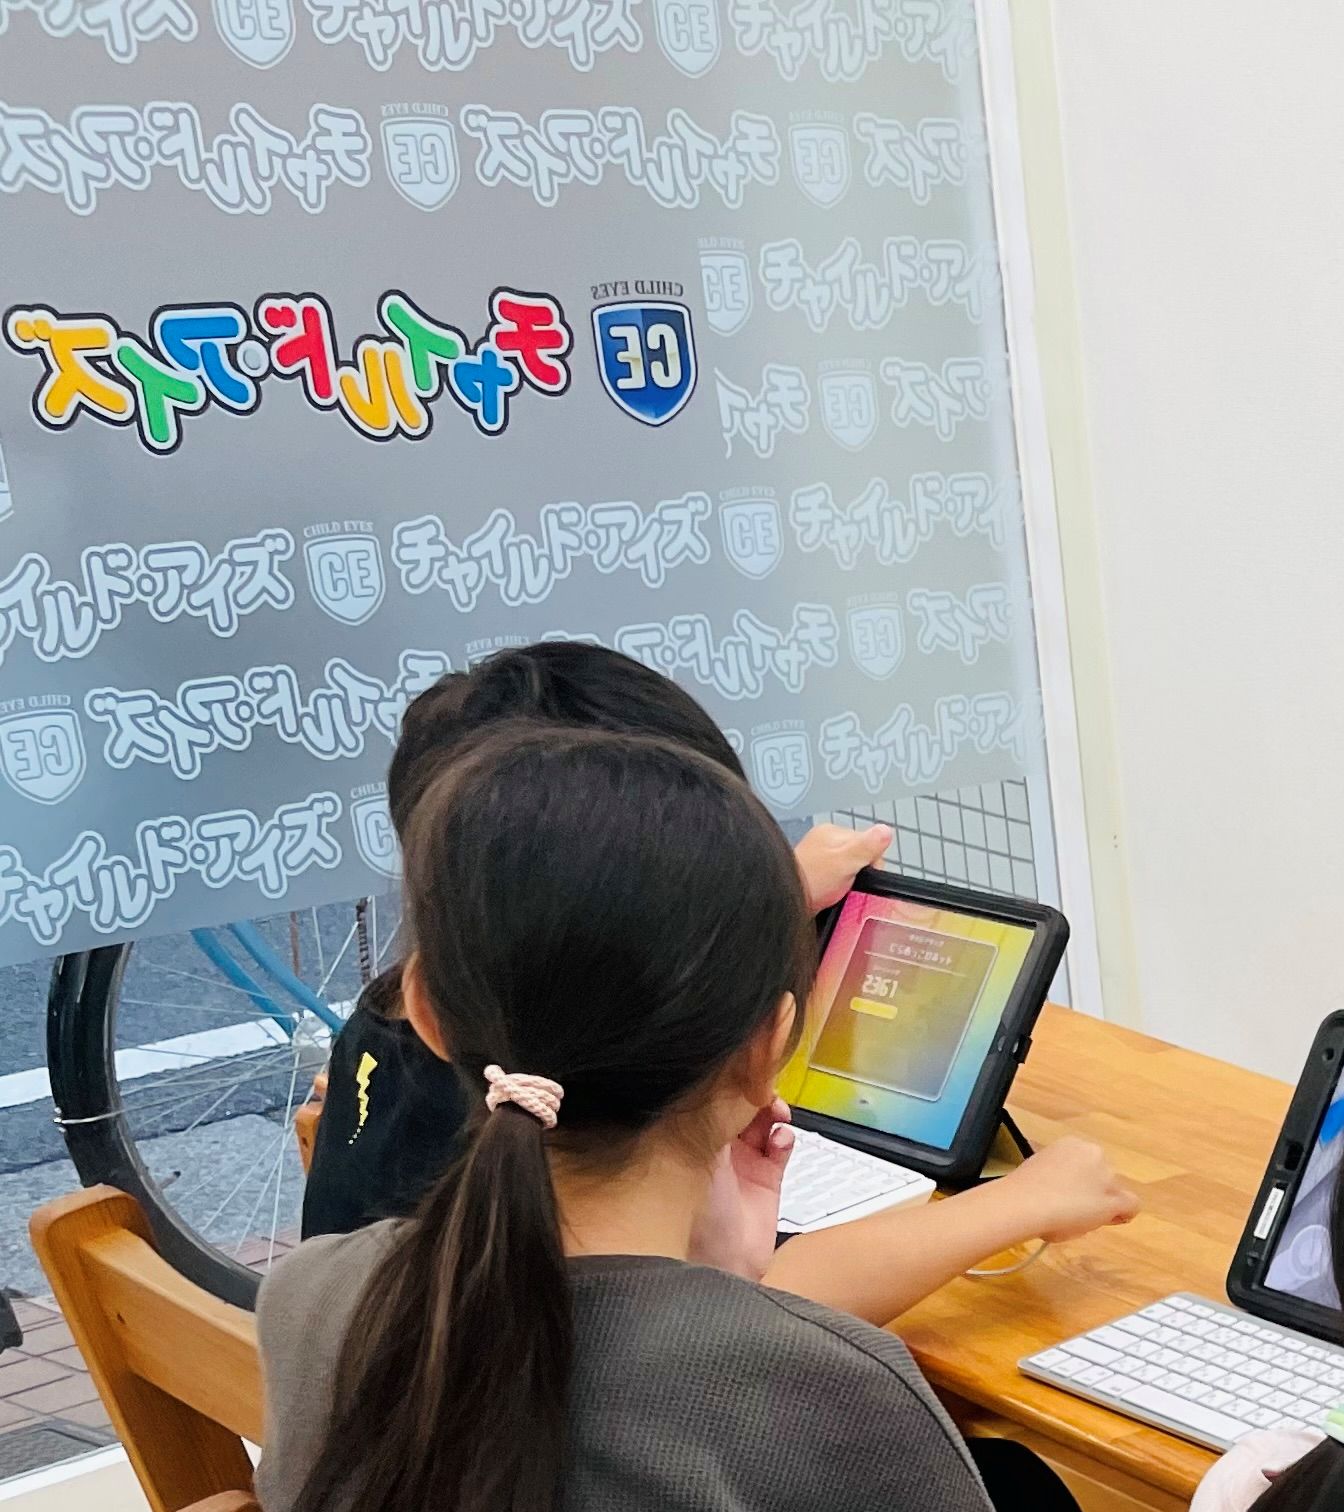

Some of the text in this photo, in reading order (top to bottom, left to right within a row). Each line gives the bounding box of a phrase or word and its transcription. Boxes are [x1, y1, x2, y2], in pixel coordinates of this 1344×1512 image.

[664, 3, 714, 53] CE
[392, 490, 712, 613] チャイルド・アイズ
[729, 512, 777, 559] CE
[319, 549, 376, 602] CE
[763, 745, 806, 789] CE
